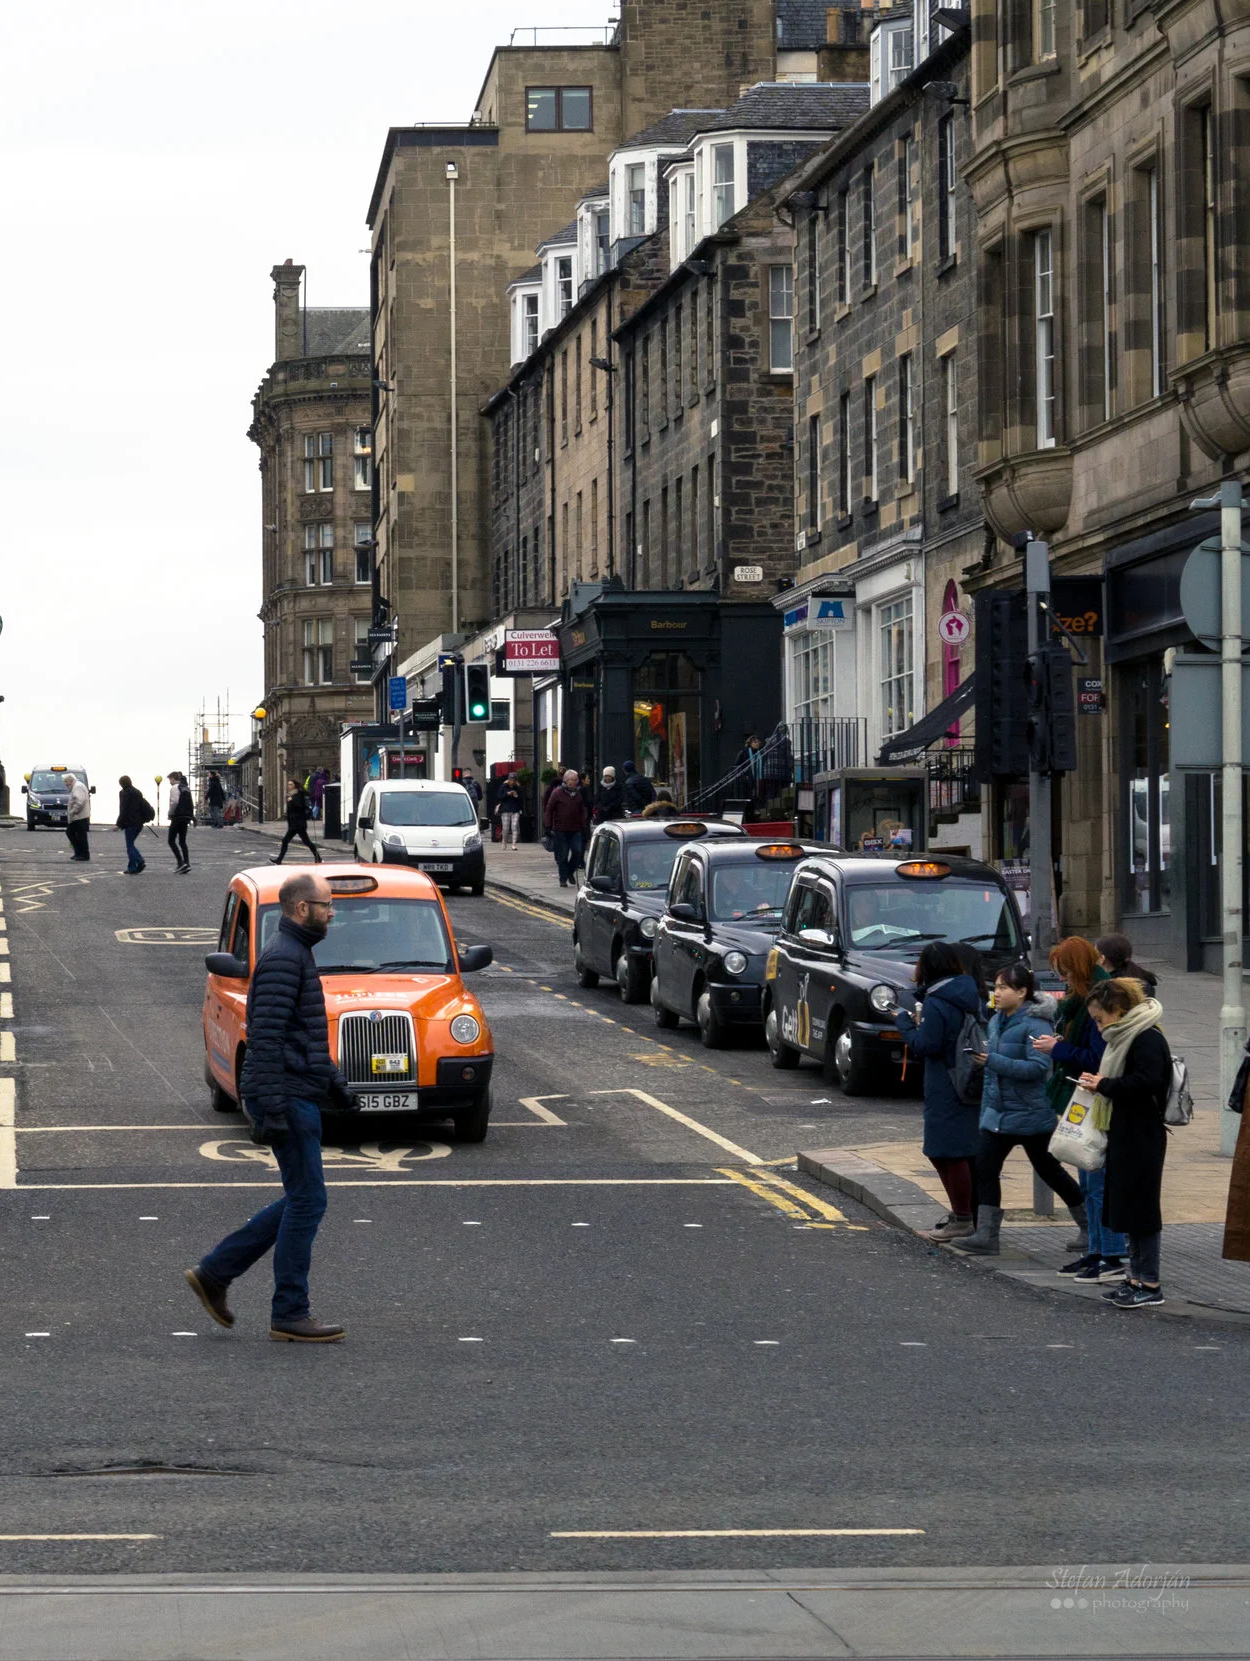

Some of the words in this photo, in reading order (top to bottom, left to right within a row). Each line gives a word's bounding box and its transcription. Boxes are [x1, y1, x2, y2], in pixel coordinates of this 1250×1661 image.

[651, 620, 687, 629] Barbour
[512, 643, 528, 656] To
[532, 643, 553, 656] Let
[781, 1004, 798, 1045] Gett
[359, 1095, 380, 1109] S15
[383, 1095, 409, 1108] GBZ
